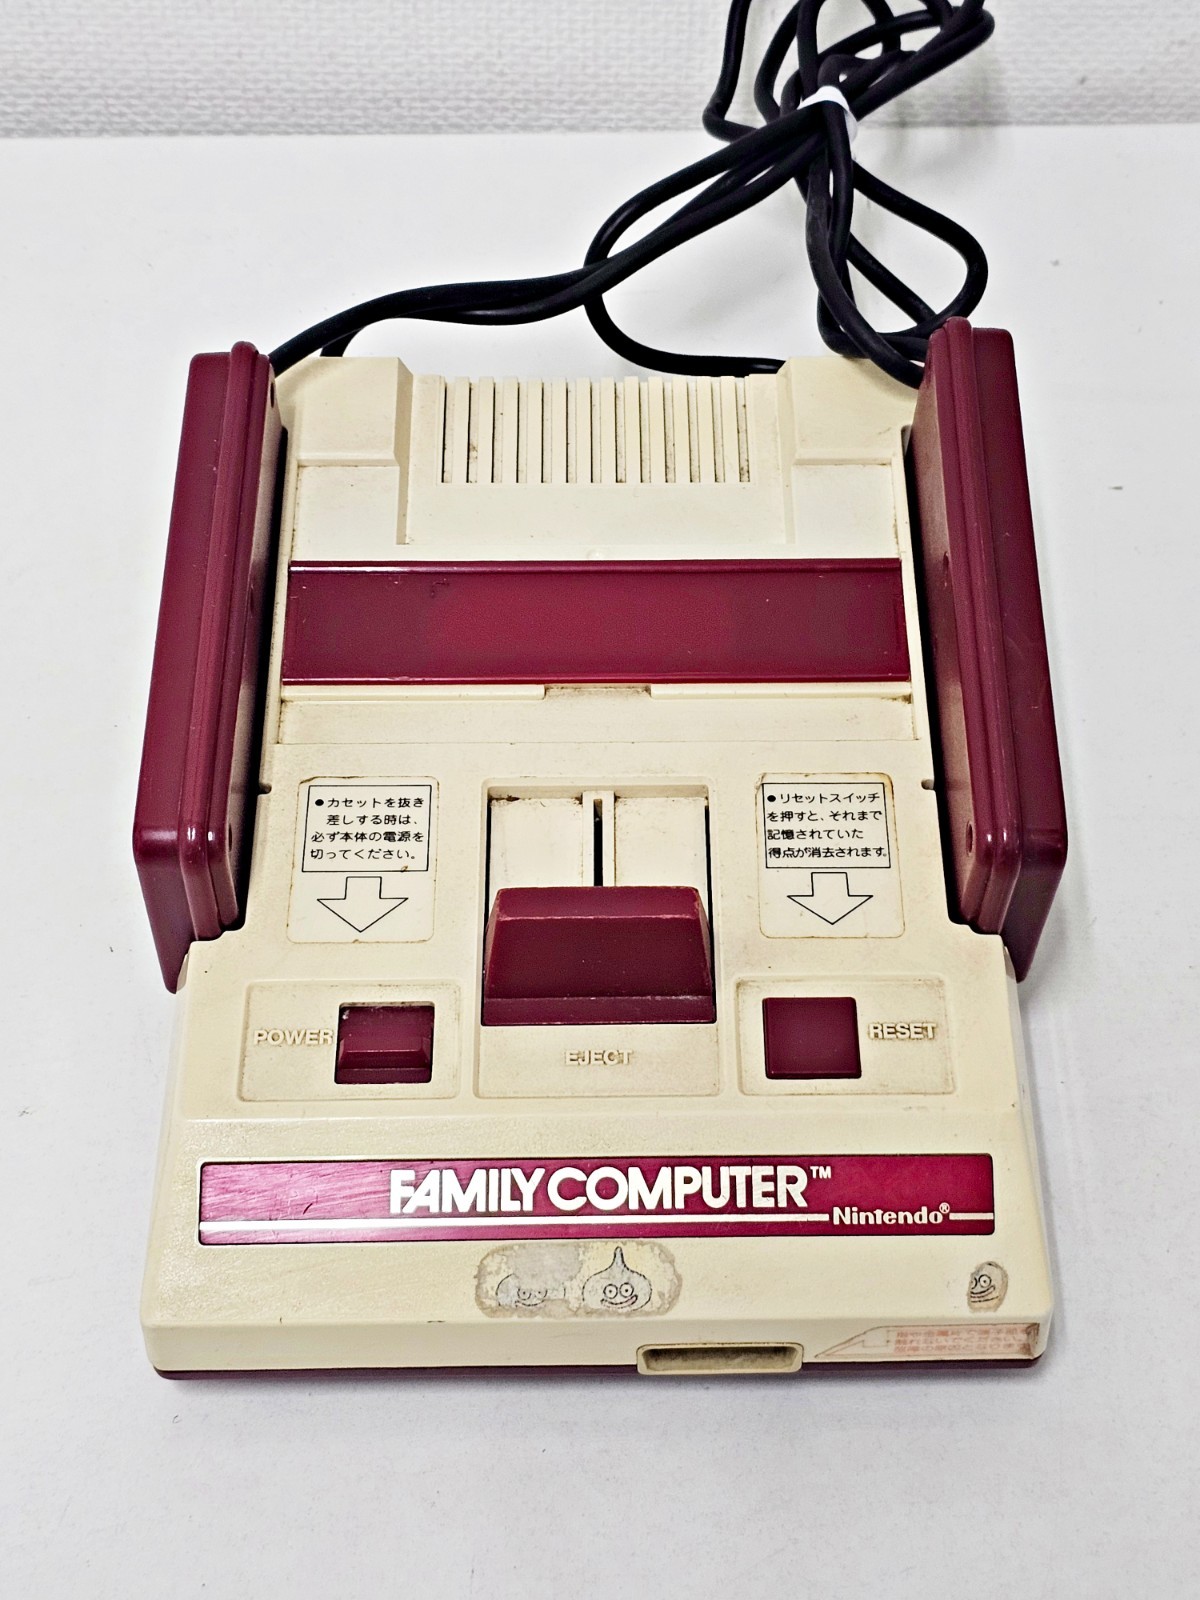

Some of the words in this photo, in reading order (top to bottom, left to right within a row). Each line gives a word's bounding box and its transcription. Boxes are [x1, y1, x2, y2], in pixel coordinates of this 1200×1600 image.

[326, 814, 418, 826] 差しする時は、
[766, 810, 883, 822] を押すと、それまで
[310, 831, 424, 843] 必ず本体の電源を
[767, 828, 864, 840] 記憶されていた
[310, 848, 416, 860] 切ってください。
[768, 846, 887, 858] 得点が消去されます。
[868, 1022, 937, 1040] RESET
[253, 1029, 334, 1046] POWER
[565, 1049, 633, 1065] EJECT
[389, 1167, 546, 1214] FAMILY
[547, 1165, 808, 1212] COMPUTER
